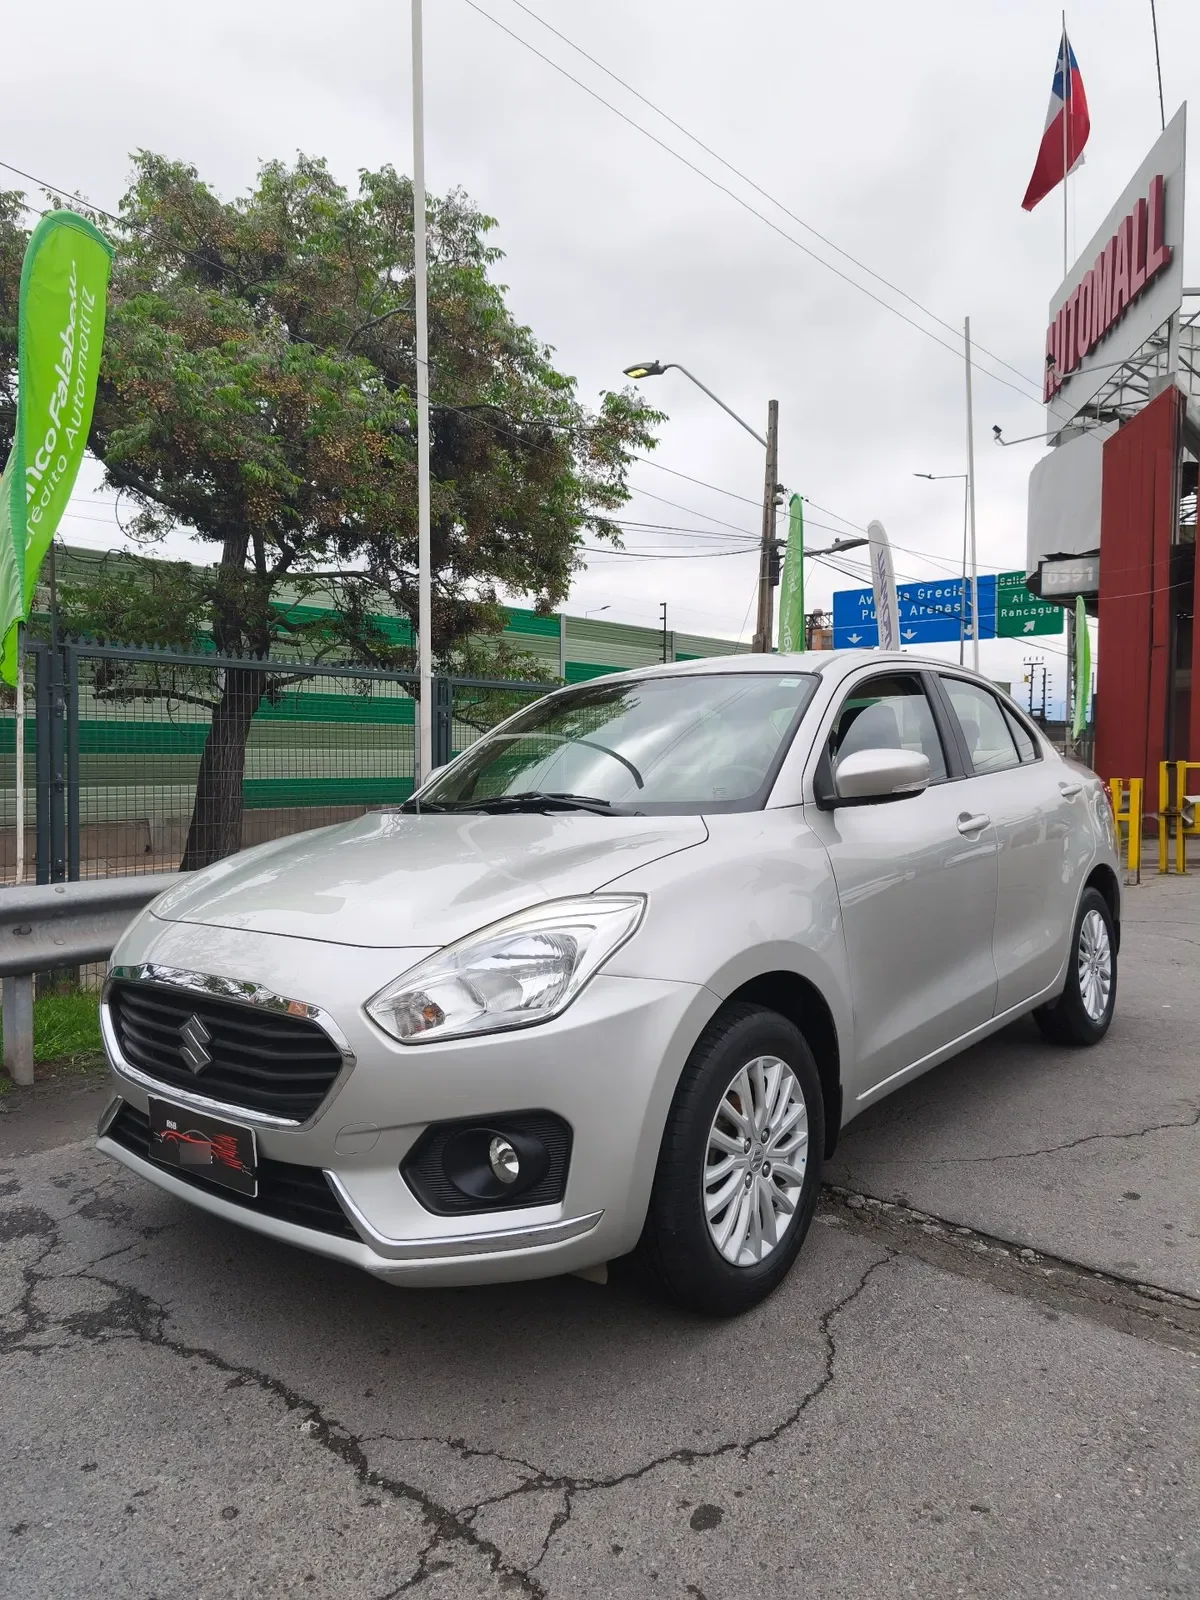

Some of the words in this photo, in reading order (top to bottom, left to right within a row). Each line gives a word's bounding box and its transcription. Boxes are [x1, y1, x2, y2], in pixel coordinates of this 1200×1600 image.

[1043, 174, 1171, 404] AUTOMALL
[65, 285, 95, 450] Automotriz
[917, 584, 964, 600] Grecia
[909, 602, 961, 617] Arenas
[1001, 606, 1060, 618] Rancagua
